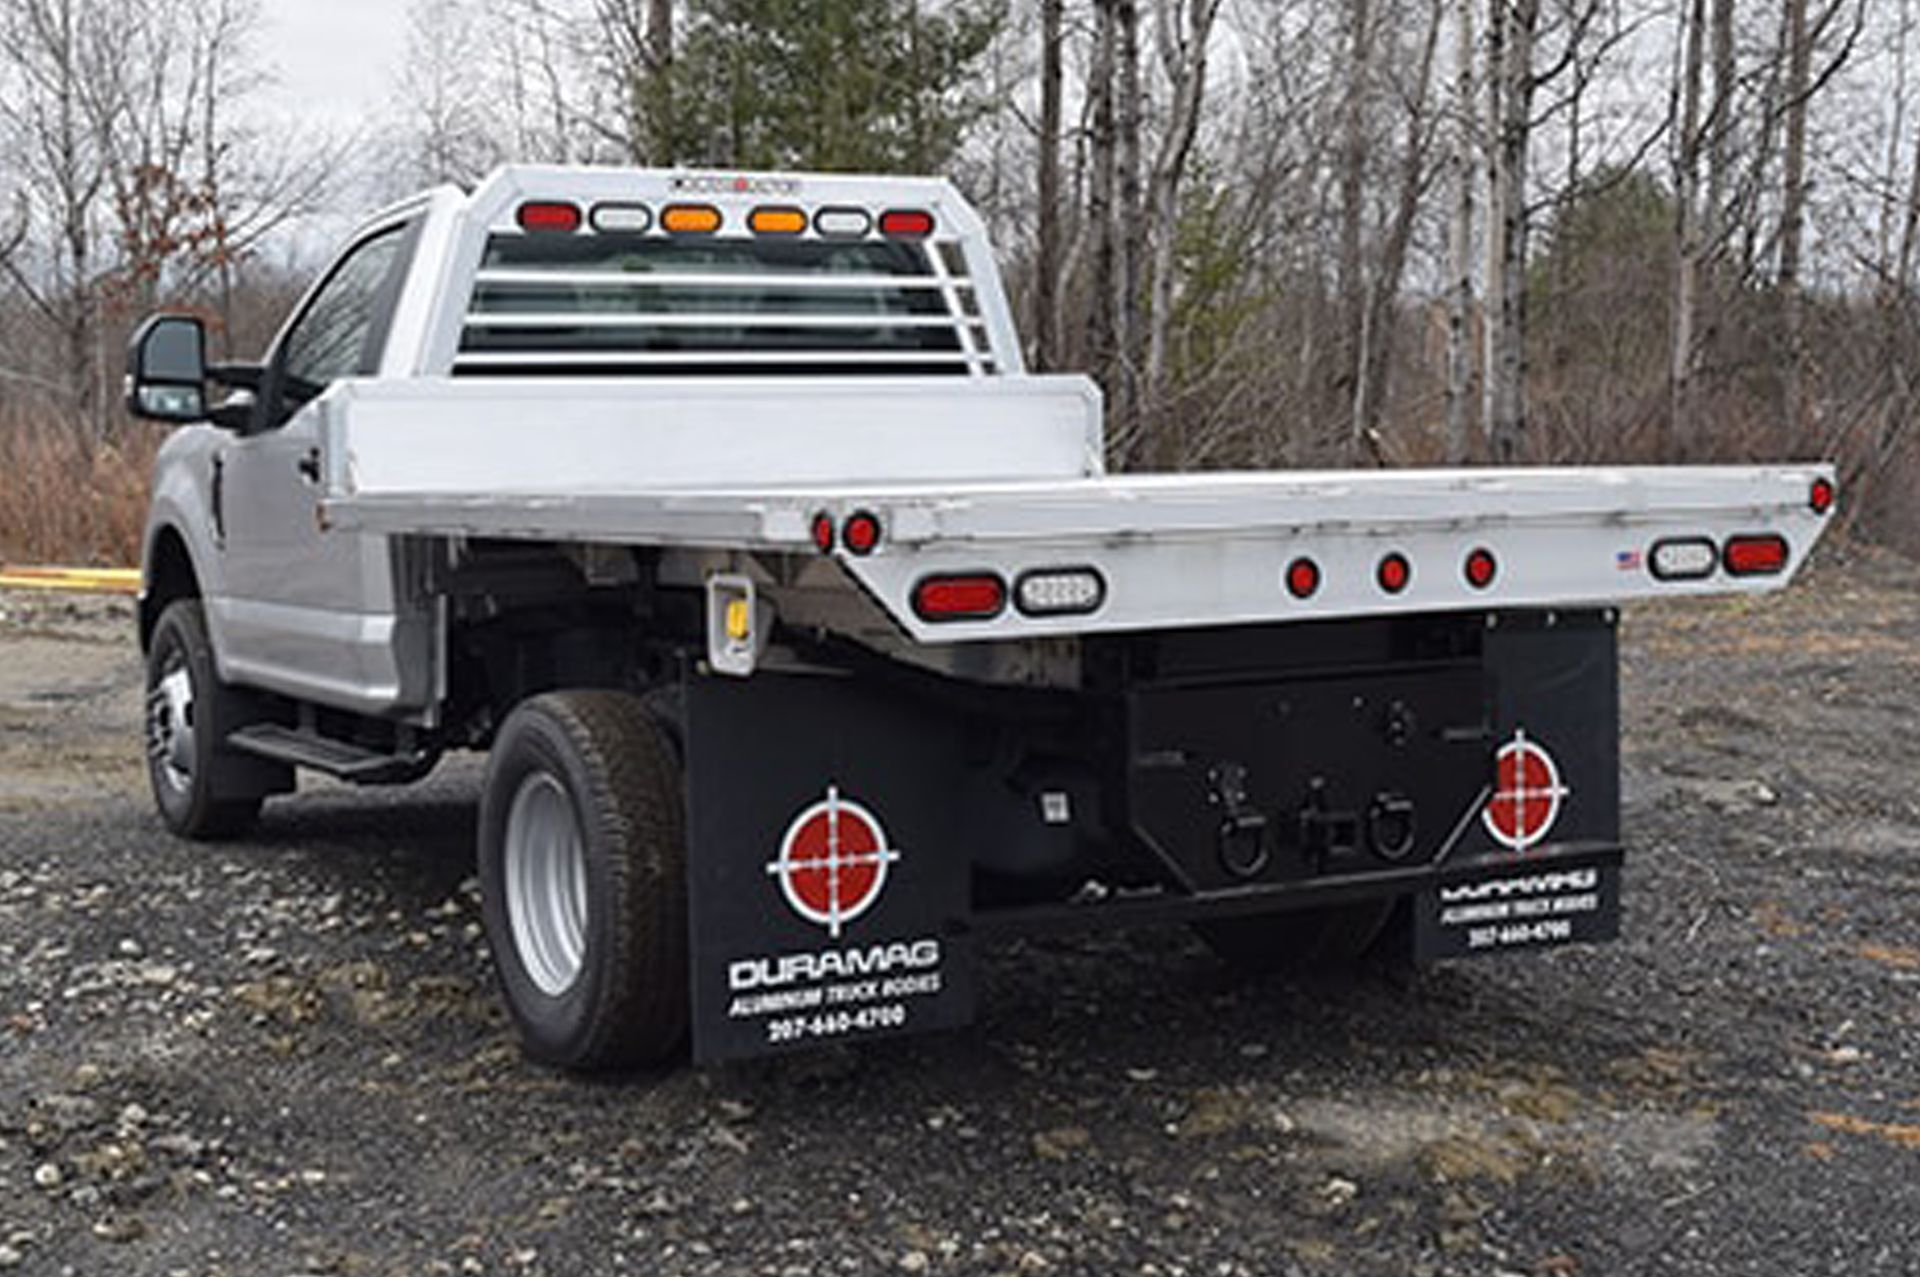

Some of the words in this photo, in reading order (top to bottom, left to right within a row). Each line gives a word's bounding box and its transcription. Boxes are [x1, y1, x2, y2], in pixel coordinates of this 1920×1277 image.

[729, 941, 939, 988] DURAMAG
[728, 988, 822, 1017] ALUMINUM
[827, 982, 877, 1001] TRUCK
[883, 974, 940, 995] BODIES
